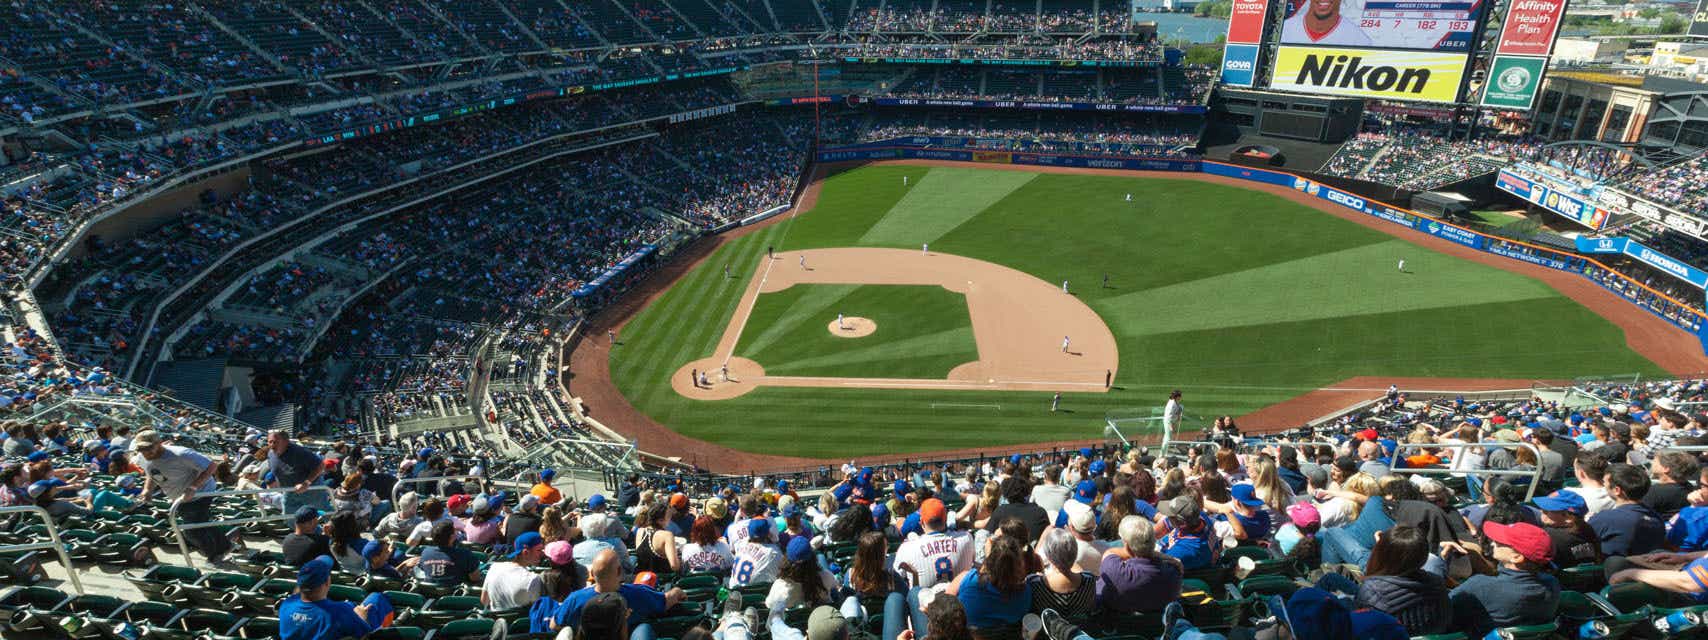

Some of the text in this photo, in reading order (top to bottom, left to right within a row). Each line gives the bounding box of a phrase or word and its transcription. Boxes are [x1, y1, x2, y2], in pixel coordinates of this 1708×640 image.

[1515, 0, 1558, 12] Affinity
[1514, 13, 1551, 23] Health
[1695, 12, 1708, 22] CL
[1360, 20, 1469, 31] 284 7 182 193
[1517, 24, 1540, 34] Plan
[1226, 60, 1251, 70] GOYA
[1295, 54, 1431, 93] Nikon
[1088, 160, 1122, 168] verizon
[1328, 190, 1363, 209] GEICO
[1557, 196, 1581, 219] WISE
[1443, 225, 1475, 239] EAST COAST
[1508, 251, 1540, 264] NETWORK
[1649, 254, 1688, 276] HONDA
[920, 538, 957, 557] CARTER
[935, 557, 954, 581] 8
